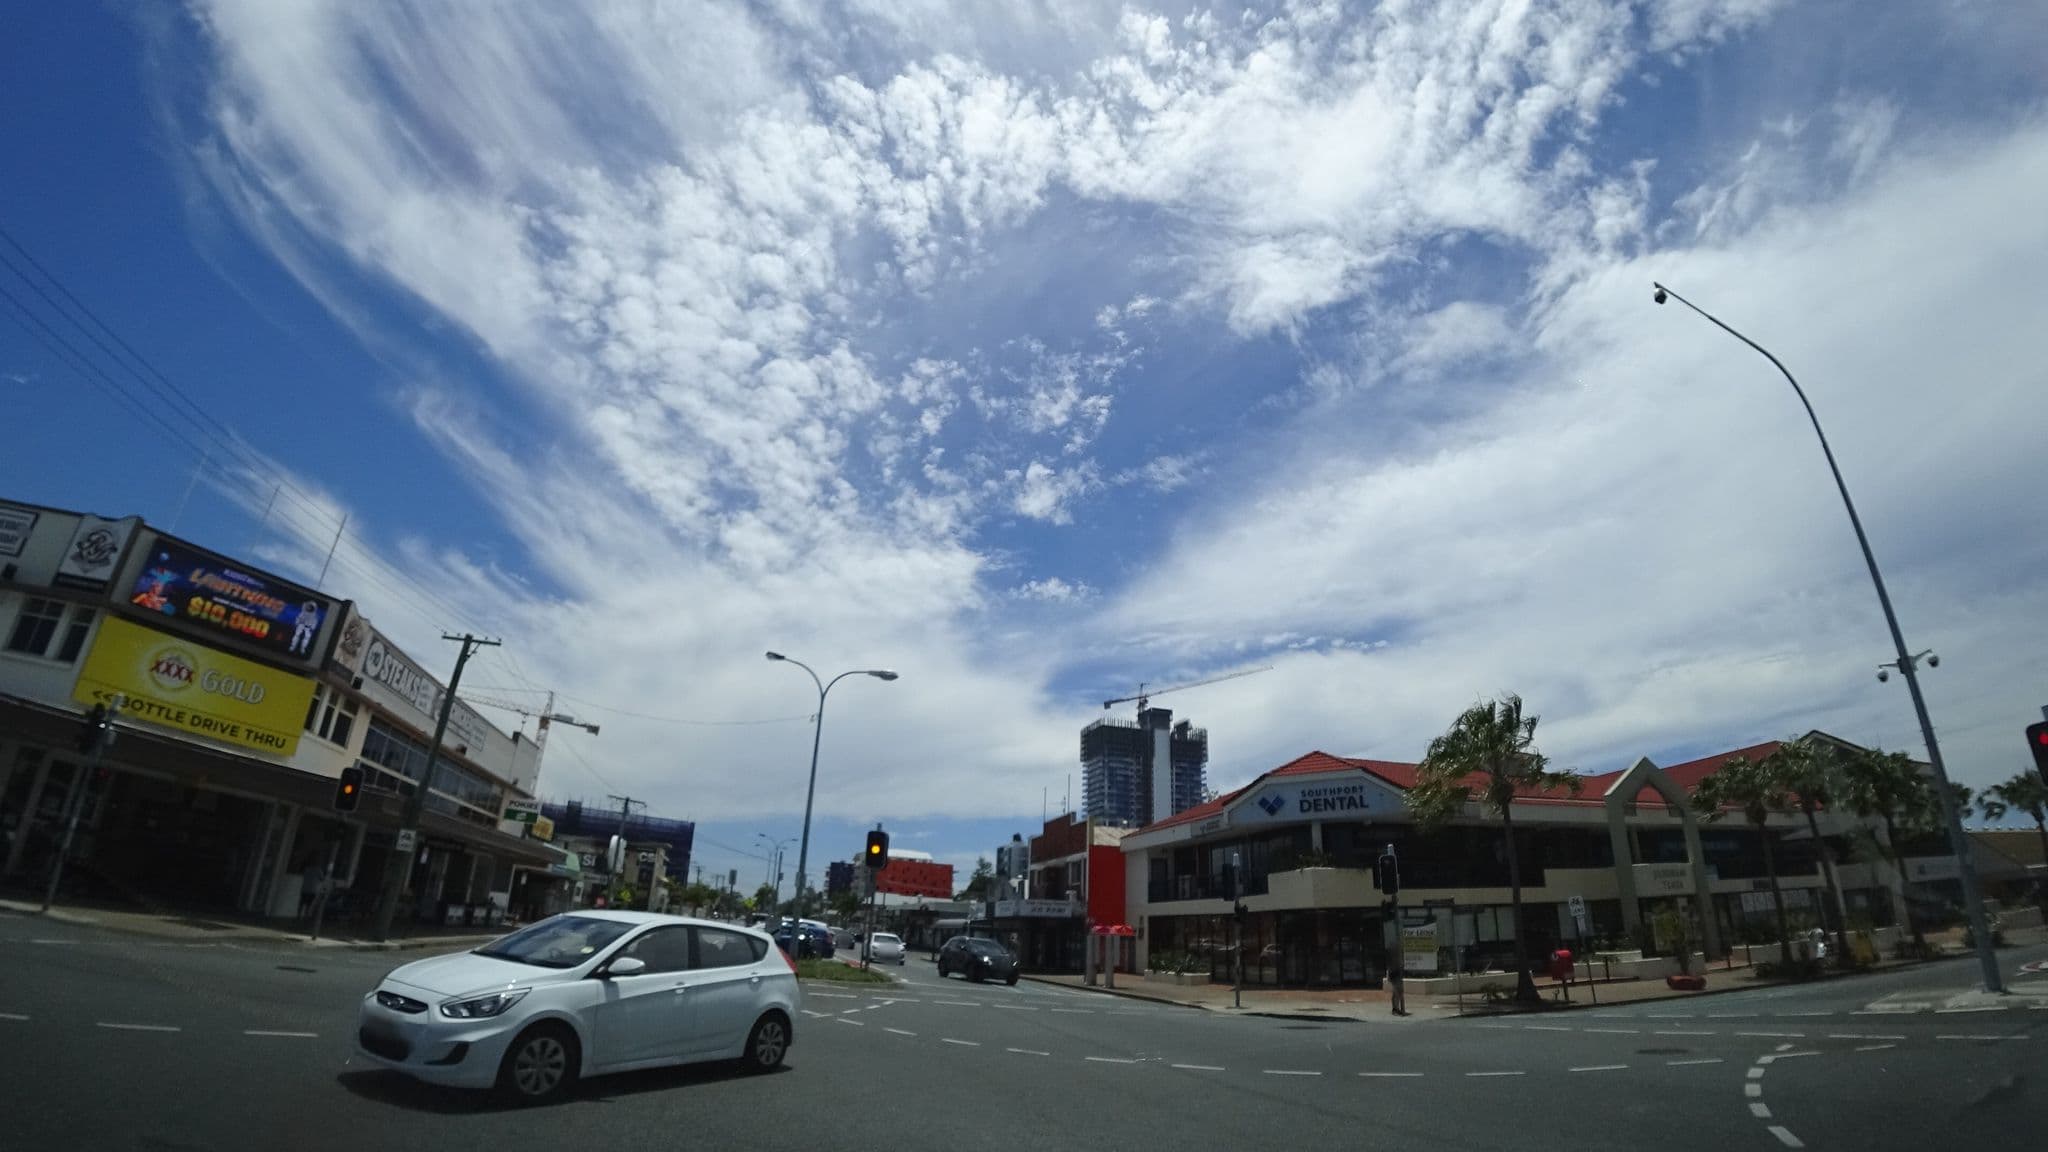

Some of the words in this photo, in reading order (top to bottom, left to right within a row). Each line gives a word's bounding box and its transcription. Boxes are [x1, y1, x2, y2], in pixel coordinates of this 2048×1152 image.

[149, 659, 194, 683] XXXX
[201, 668, 266, 705] GOLD
[380, 652, 421, 701] STEAKS
[121, 695, 185, 723] BOTTLE
[190, 714, 239, 737] DRIVE
[244, 728, 286, 749] THRU
[1299, 794, 1369, 813] DENTAL
[1300, 785, 1364, 798] SOUTHPORT
